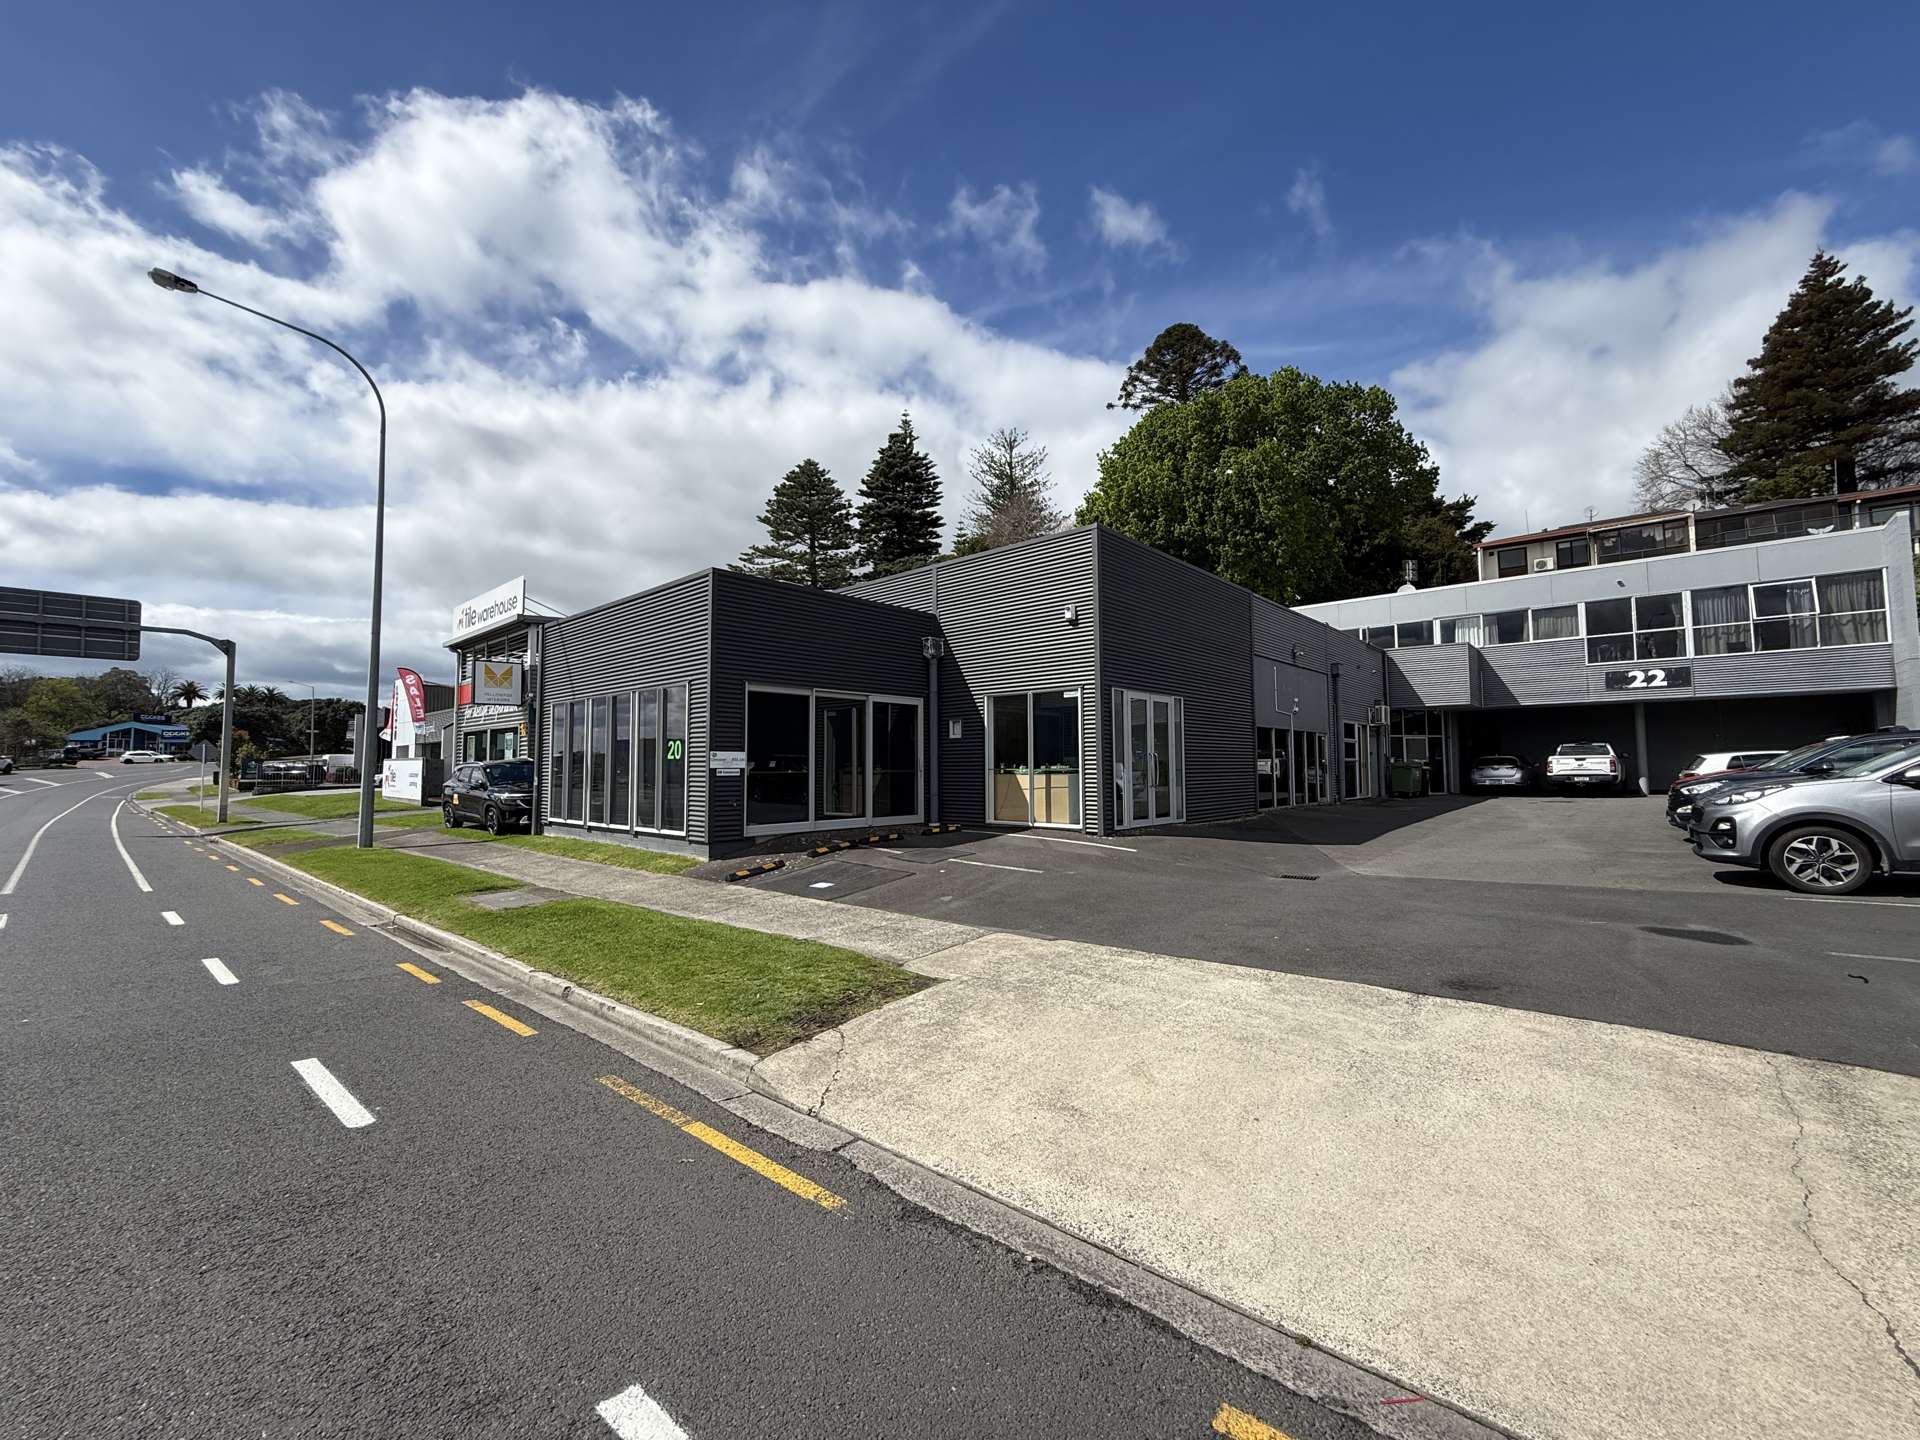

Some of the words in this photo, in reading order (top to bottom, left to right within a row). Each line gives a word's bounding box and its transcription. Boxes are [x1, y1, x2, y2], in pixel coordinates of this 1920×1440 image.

[465, 604, 477, 629] tile
[477, 595, 518, 624] warehouse
[1625, 669, 1668, 688] 22
[667, 740, 682, 760] 20
